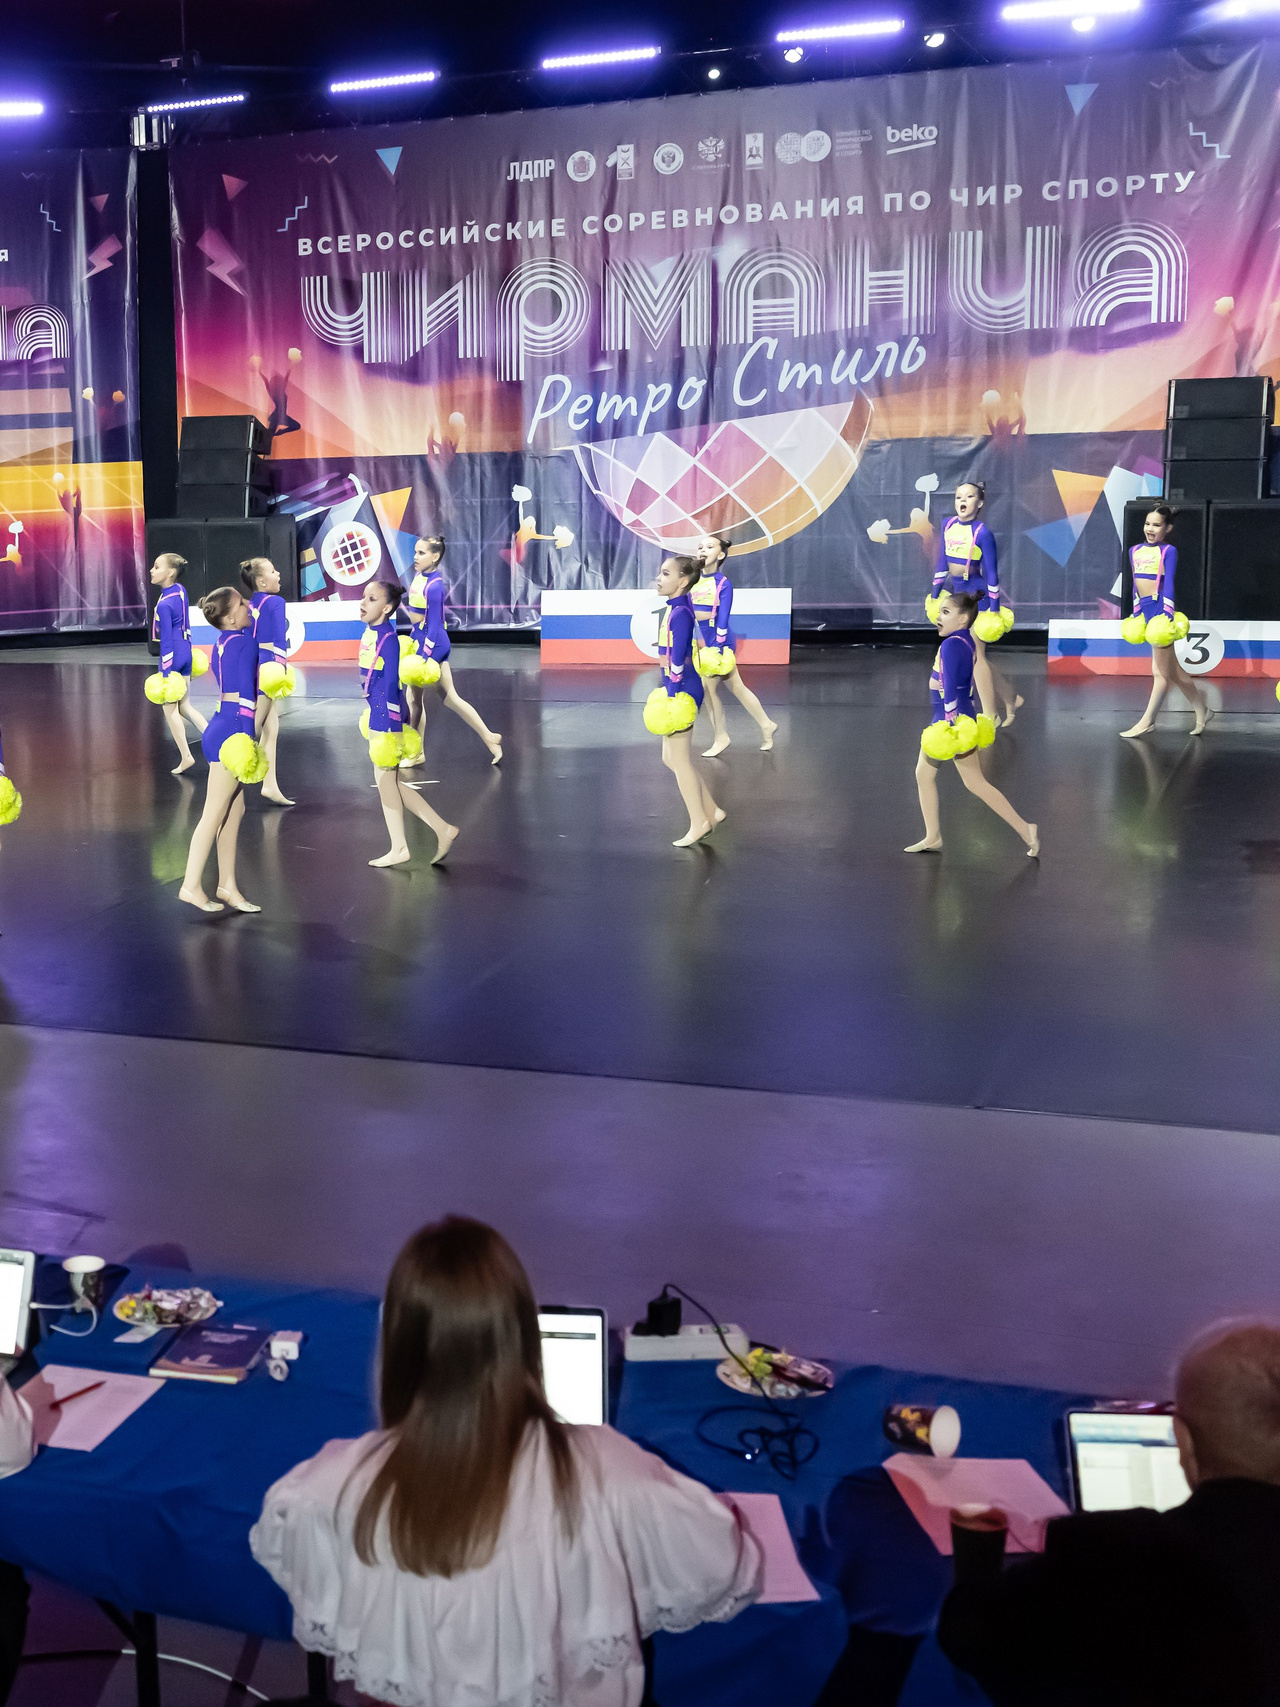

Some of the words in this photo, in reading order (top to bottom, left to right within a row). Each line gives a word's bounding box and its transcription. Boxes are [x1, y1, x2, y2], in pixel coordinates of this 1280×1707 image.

[886, 124, 939, 144] beko
[506, 159, 556, 182] ЛДПР
[297, 218, 567, 256] ВСЕРОССИЙСКИЕ
[582, 195, 865, 235] СОРЕВНОВАНИЯ
[884, 190, 932, 213] ПО
[950, 184, 1024, 209] ЧИР
[1042, 170, 1196, 202] СПОРТУ
[526, 372, 708, 444] Ретро
[731, 331, 928, 406] Стиль
[1184, 633, 1210, 665] 3
